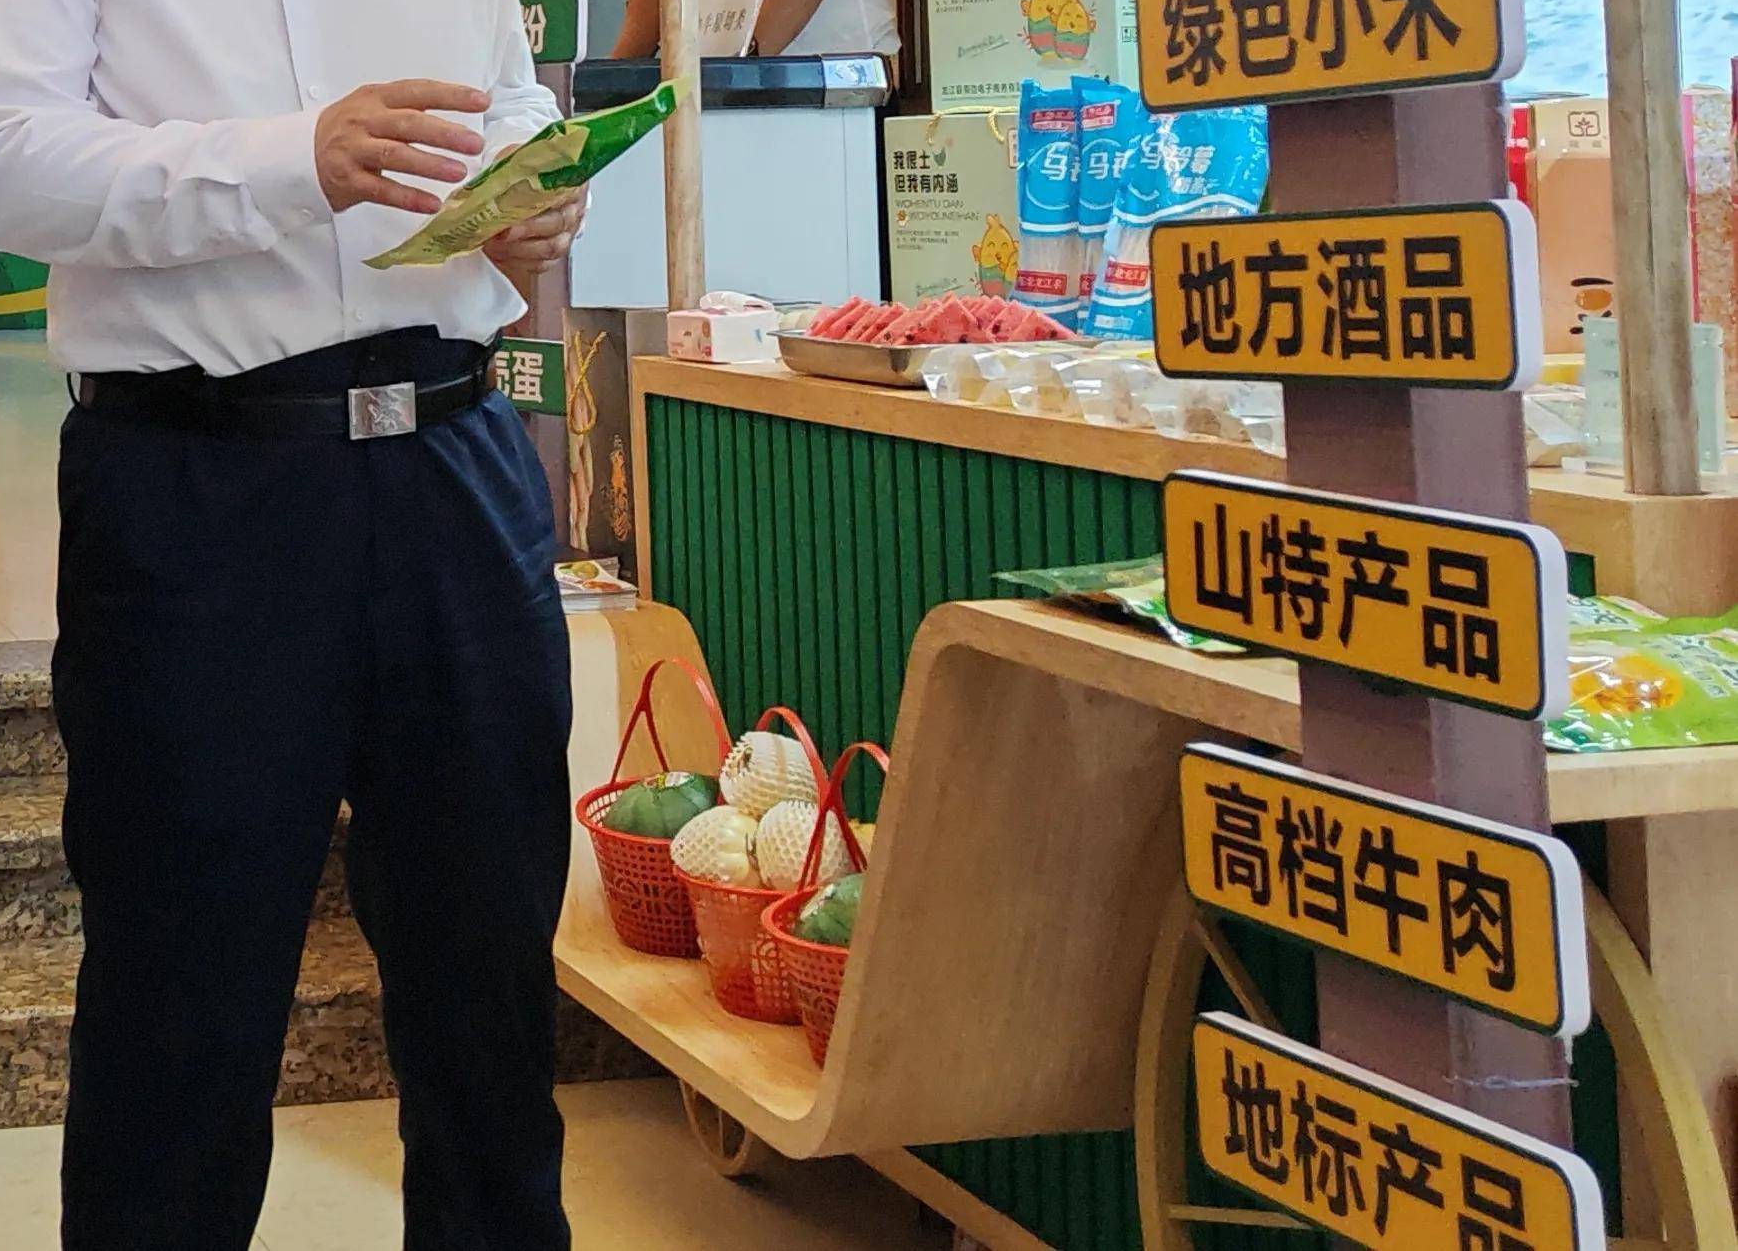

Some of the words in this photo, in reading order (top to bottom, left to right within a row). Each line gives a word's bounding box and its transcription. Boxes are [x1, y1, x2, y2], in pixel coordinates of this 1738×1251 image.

[893, 149, 931, 170] 我很土
[894, 173, 959, 193] 但我有内涵
[1178, 236, 1477, 362] 地方酒品
[1194, 502, 1500, 684] 山特产品
[1205, 781, 1517, 993] 高档牛肉
[1221, 1047, 1534, 1251] 地标产品
